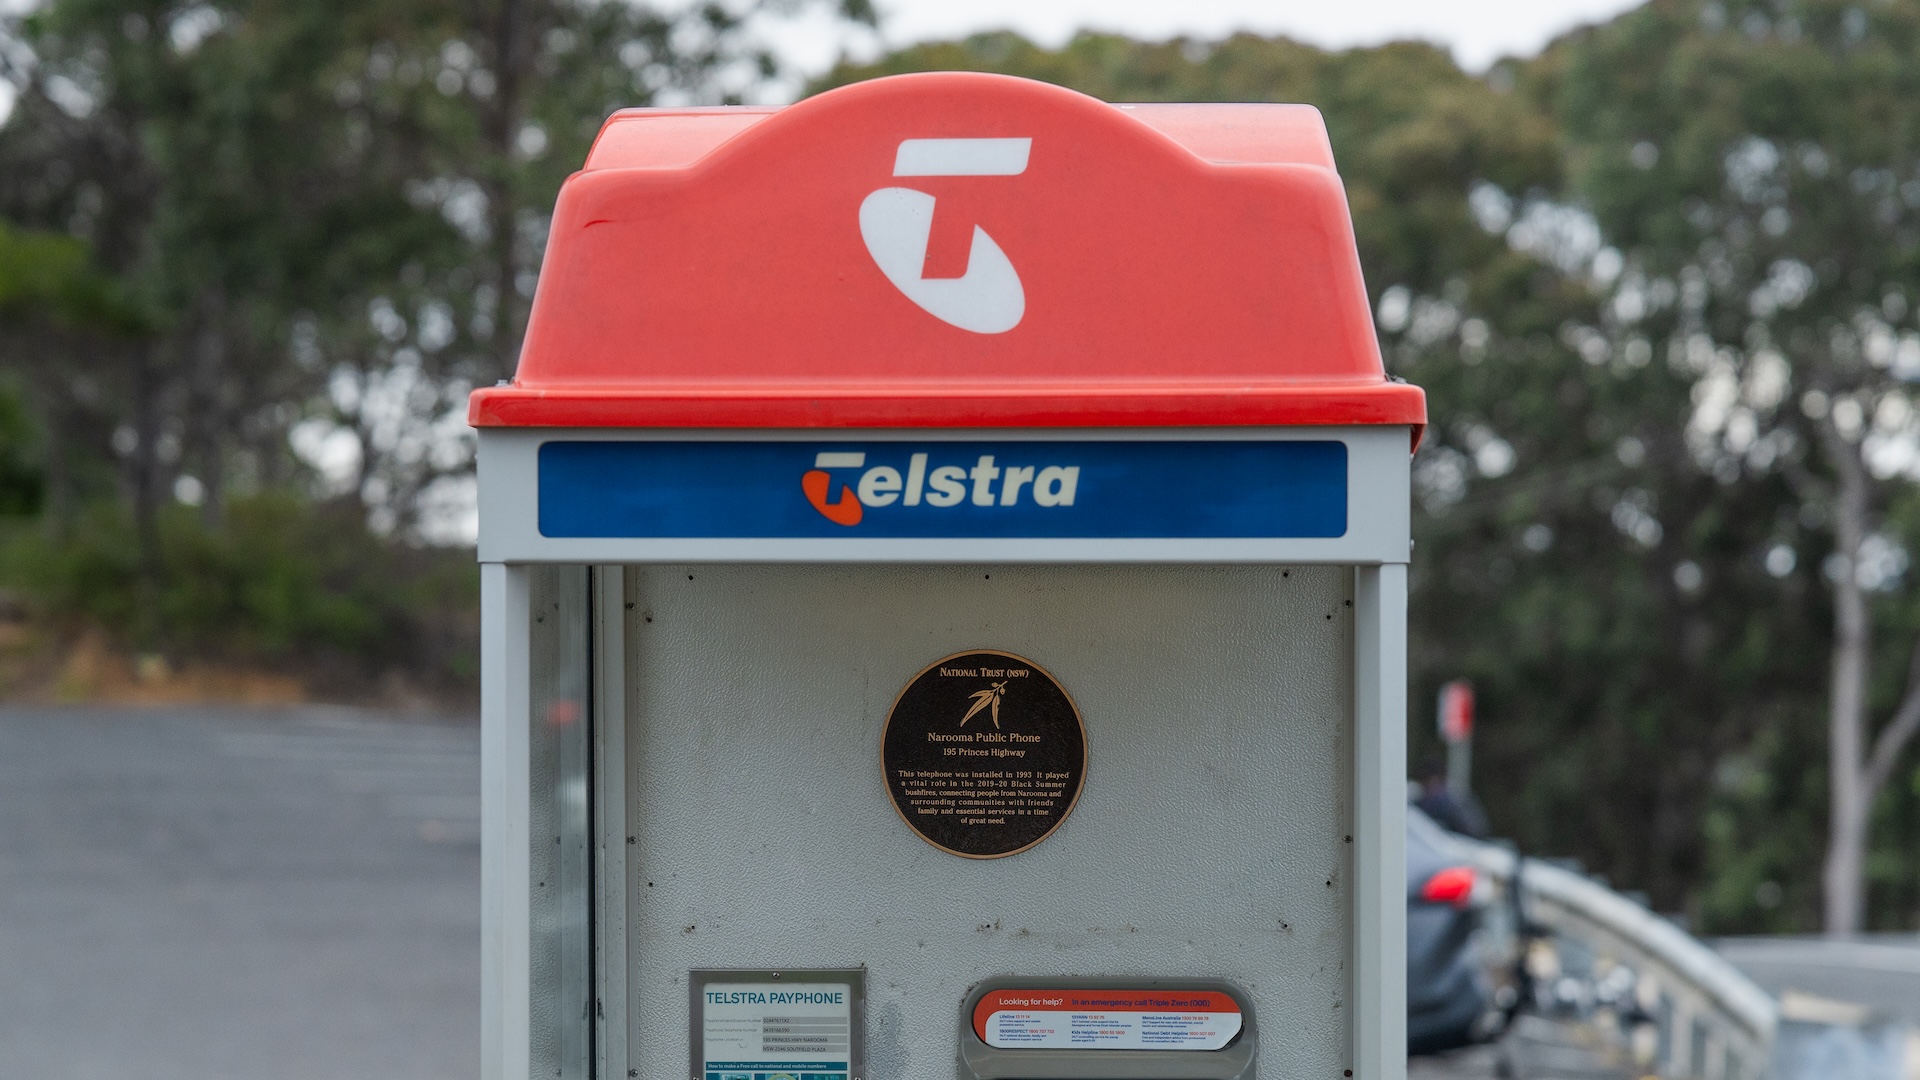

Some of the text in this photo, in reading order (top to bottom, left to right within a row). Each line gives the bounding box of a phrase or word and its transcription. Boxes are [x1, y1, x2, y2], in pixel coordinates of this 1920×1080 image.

[802, 452, 1080, 526] Telstra
[1006, 668, 1029, 678] (NSW)
[928, 732, 1040, 742] Narooma Public Phone
[943, 748, 1026, 758] 195 Princes Highway
[917, 771, 952, 779] telephone
[1046, 772, 1070, 780] played
[905, 789, 938, 797] bushfires,
[939, 790, 976, 798] connecting
[706, 992, 843, 1004] TELSTRA PAYPHONE
